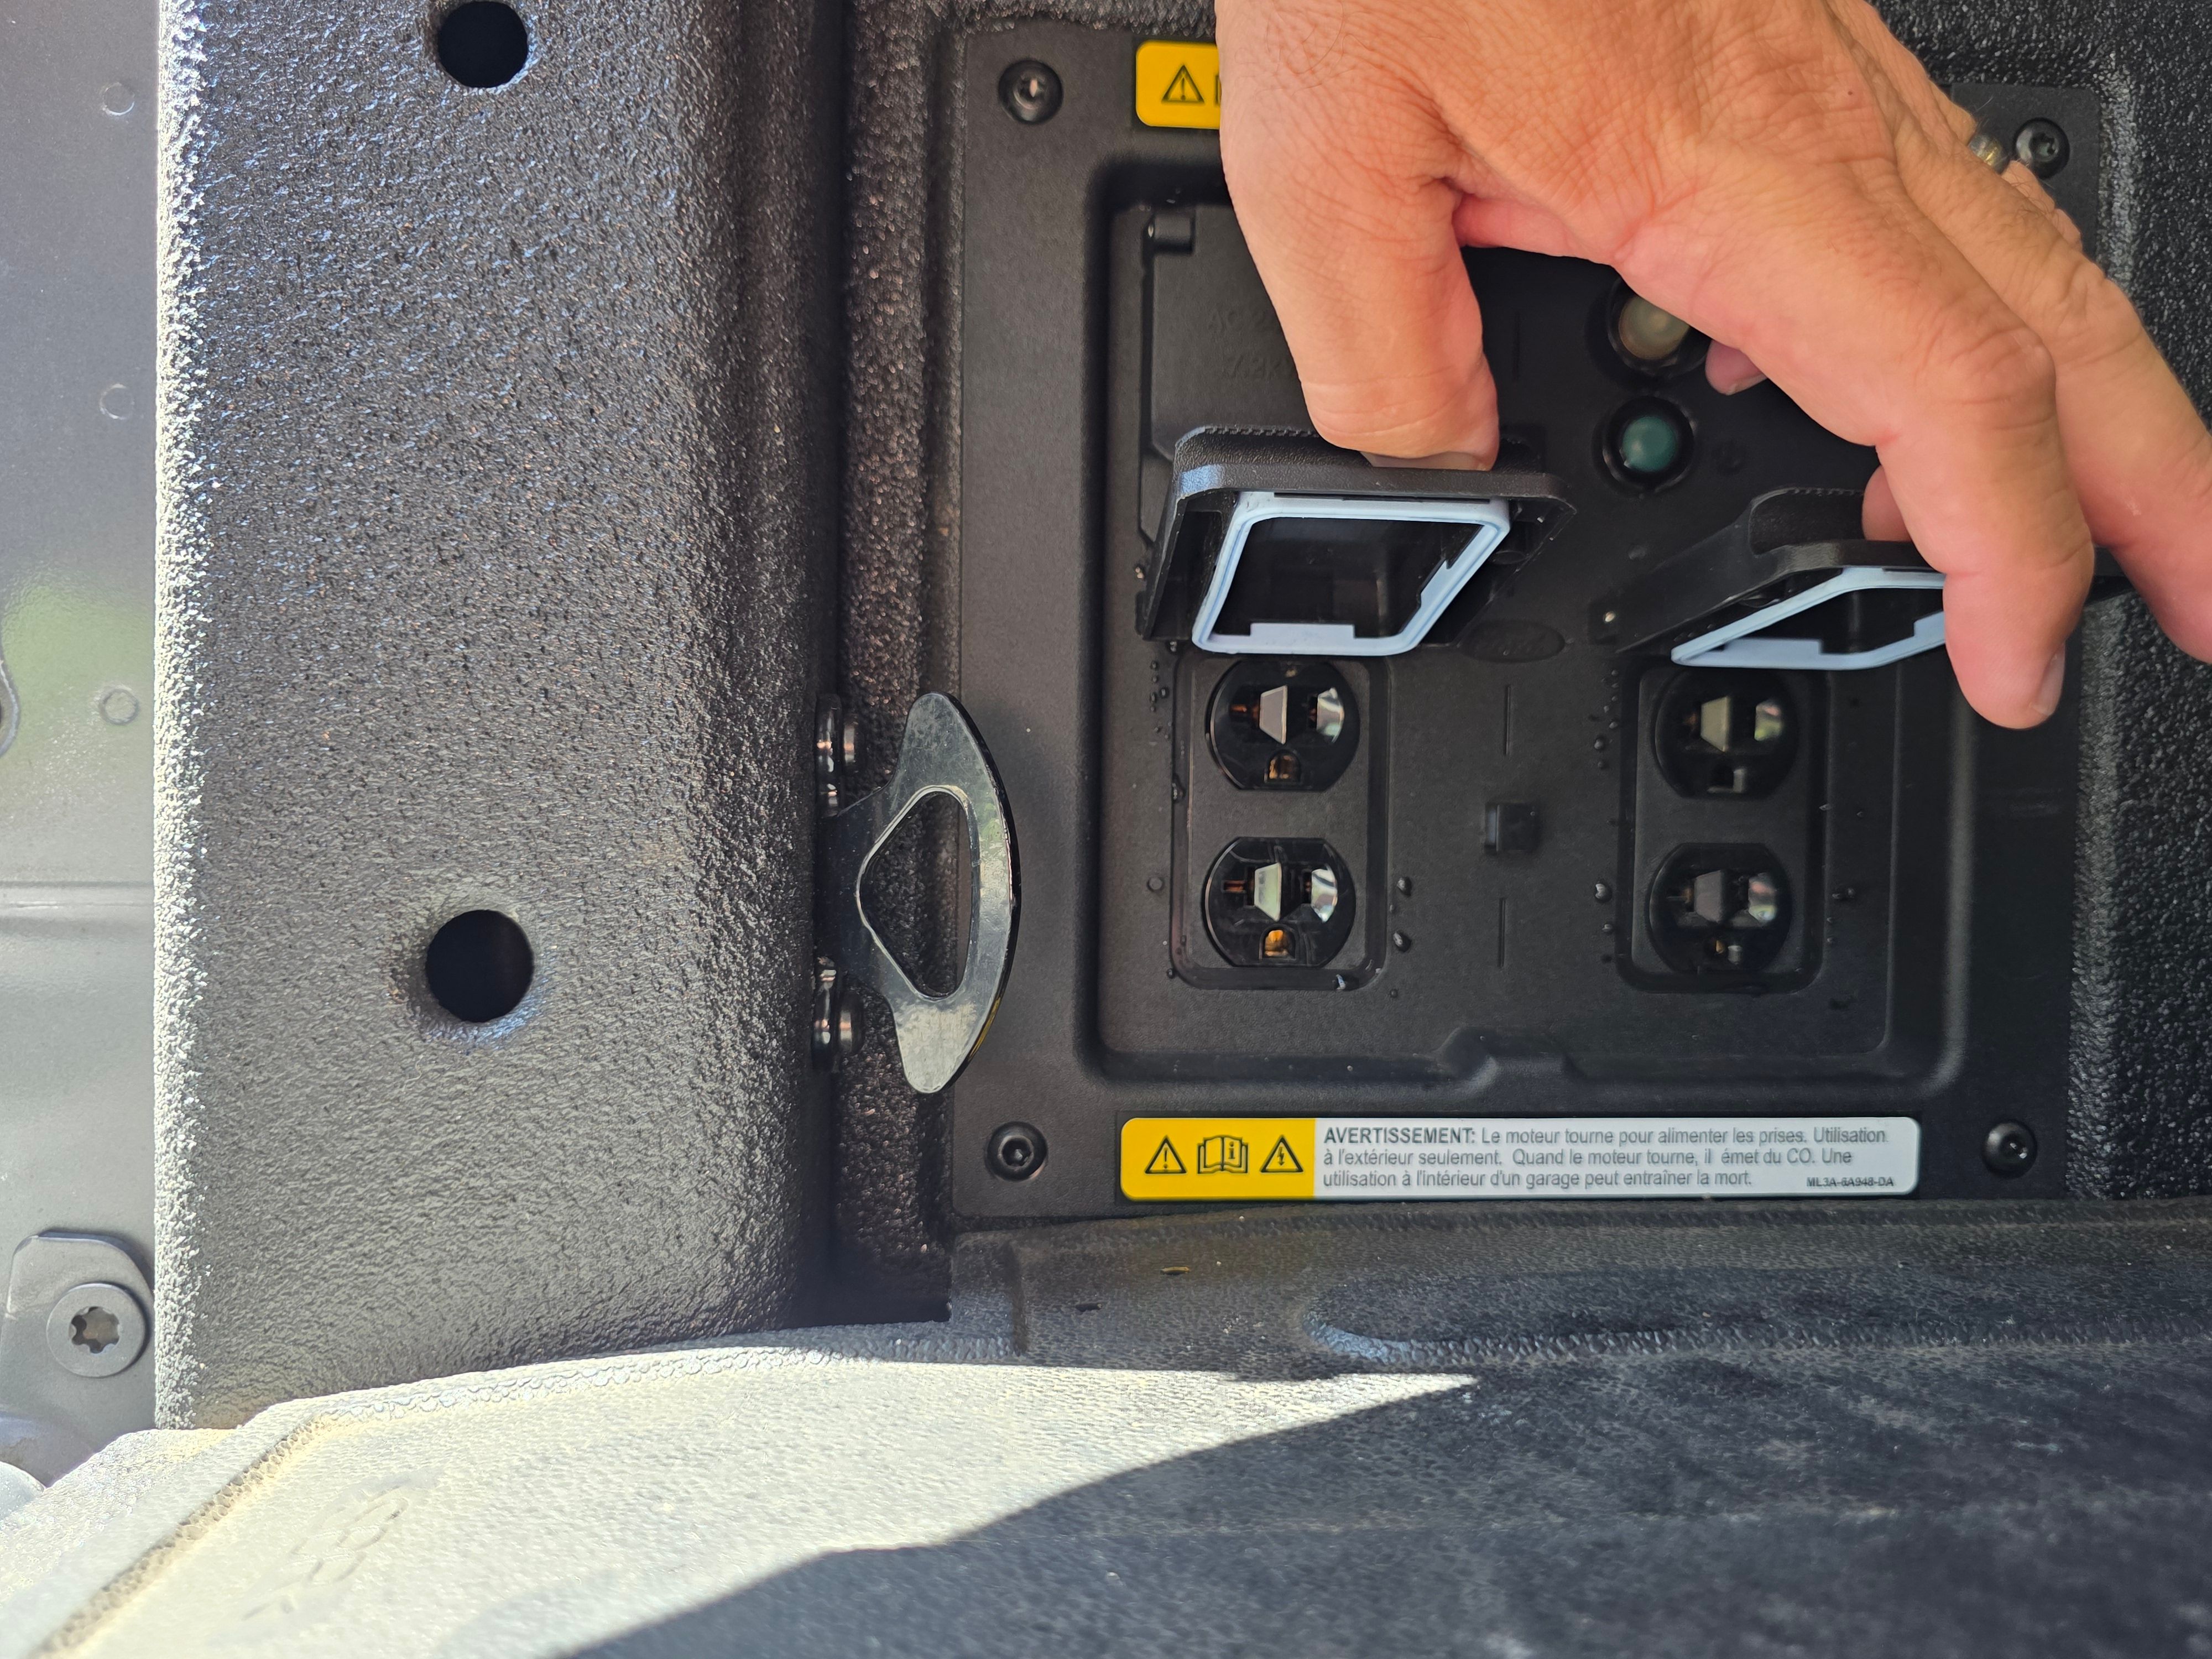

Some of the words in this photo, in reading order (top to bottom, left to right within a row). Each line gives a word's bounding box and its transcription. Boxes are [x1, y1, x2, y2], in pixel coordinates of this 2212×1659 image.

[1324, 1127, 1475, 1144] AVERTISSEMENT:
[1482, 1128, 1500, 1144] Le
[1506, 1129, 1560, 1144] moteur
[1565, 1129, 1614, 1144] tourne
[1619, 1131, 1653, 1147] pour
[1658, 1128, 1728, 1143] alimenter
[1733, 1128, 1754, 1143] les
[1759, 1128, 1807, 1146] prises.
[1324, 1149, 1333, 1165] à
[1339, 1149, 1413, 1165] l'extérieur
[1419, 1149, 1502, 1165] seulement.
[1512, 1149, 1563, 1166] Quand
[1570, 1149, 1583, 1165] le
[1588, 1150, 1642, 1165] moteur
[1647, 1150, 1698, 1166] tourne,
[1704, 1149, 1712, 1164] il
[1721, 1148, 1759, 1164] émet
[1764, 1149, 1781, 1164] du
[1787, 1148, 1815, 1164] CO.
[1822, 1148, 1852, 1164] Une
[1323, 1170, 1396, 1187] utilisation
[1402, 1170, 1411, 1186] à
[1417, 1170, 1485, 1186] l'intérieur
[1490, 1170, 1520, 1186] d'un
[1526, 1174, 1579, 1190] garage
[1585, 1171, 1619, 1189] peut
[1624, 1170, 1692, 1185] entraîner
[1697, 1170, 1710, 1185] la
[1715, 1171, 1751, 1185] mort.
